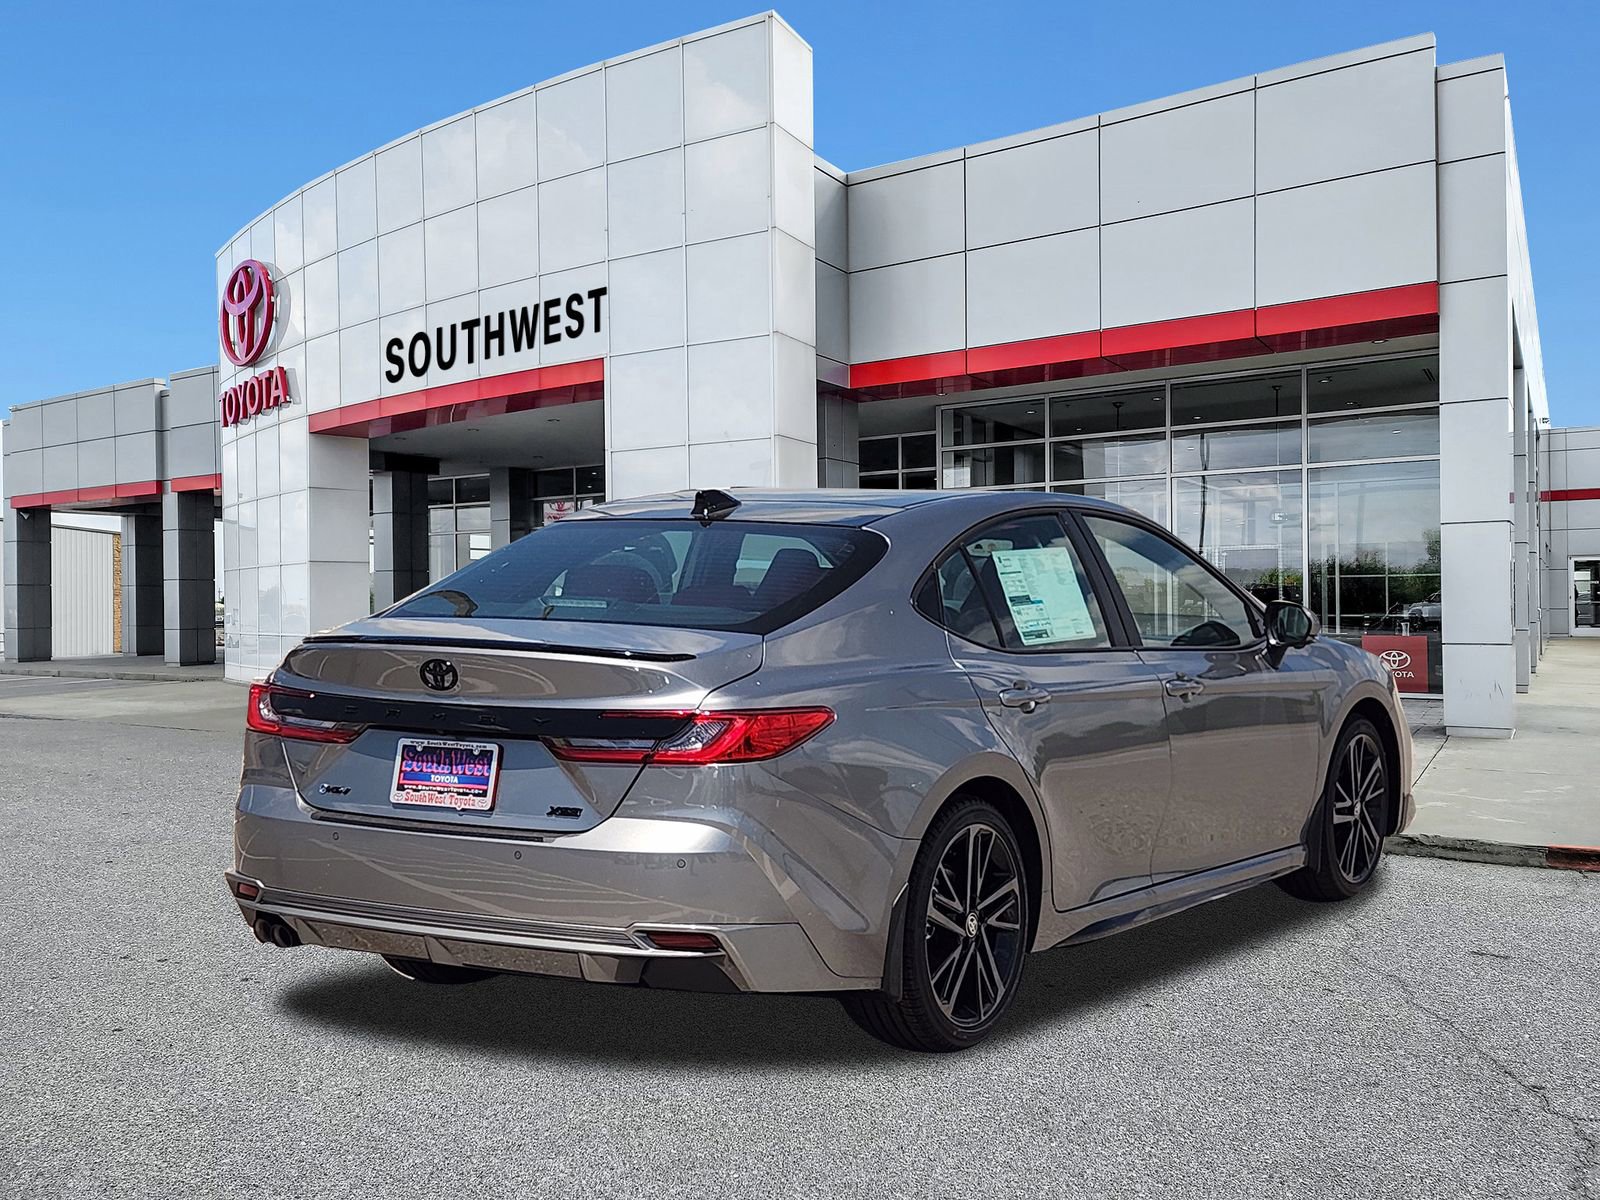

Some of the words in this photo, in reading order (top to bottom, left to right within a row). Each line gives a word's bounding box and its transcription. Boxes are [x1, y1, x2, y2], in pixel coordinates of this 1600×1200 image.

[385, 286, 608, 384] SOUTHWEST
[218, 366, 289, 428] TOYOTA
[430, 774, 459, 784] TOYOTA
[404, 791, 447, 804] SouthWest
[448, 794, 476, 808] Toyota
